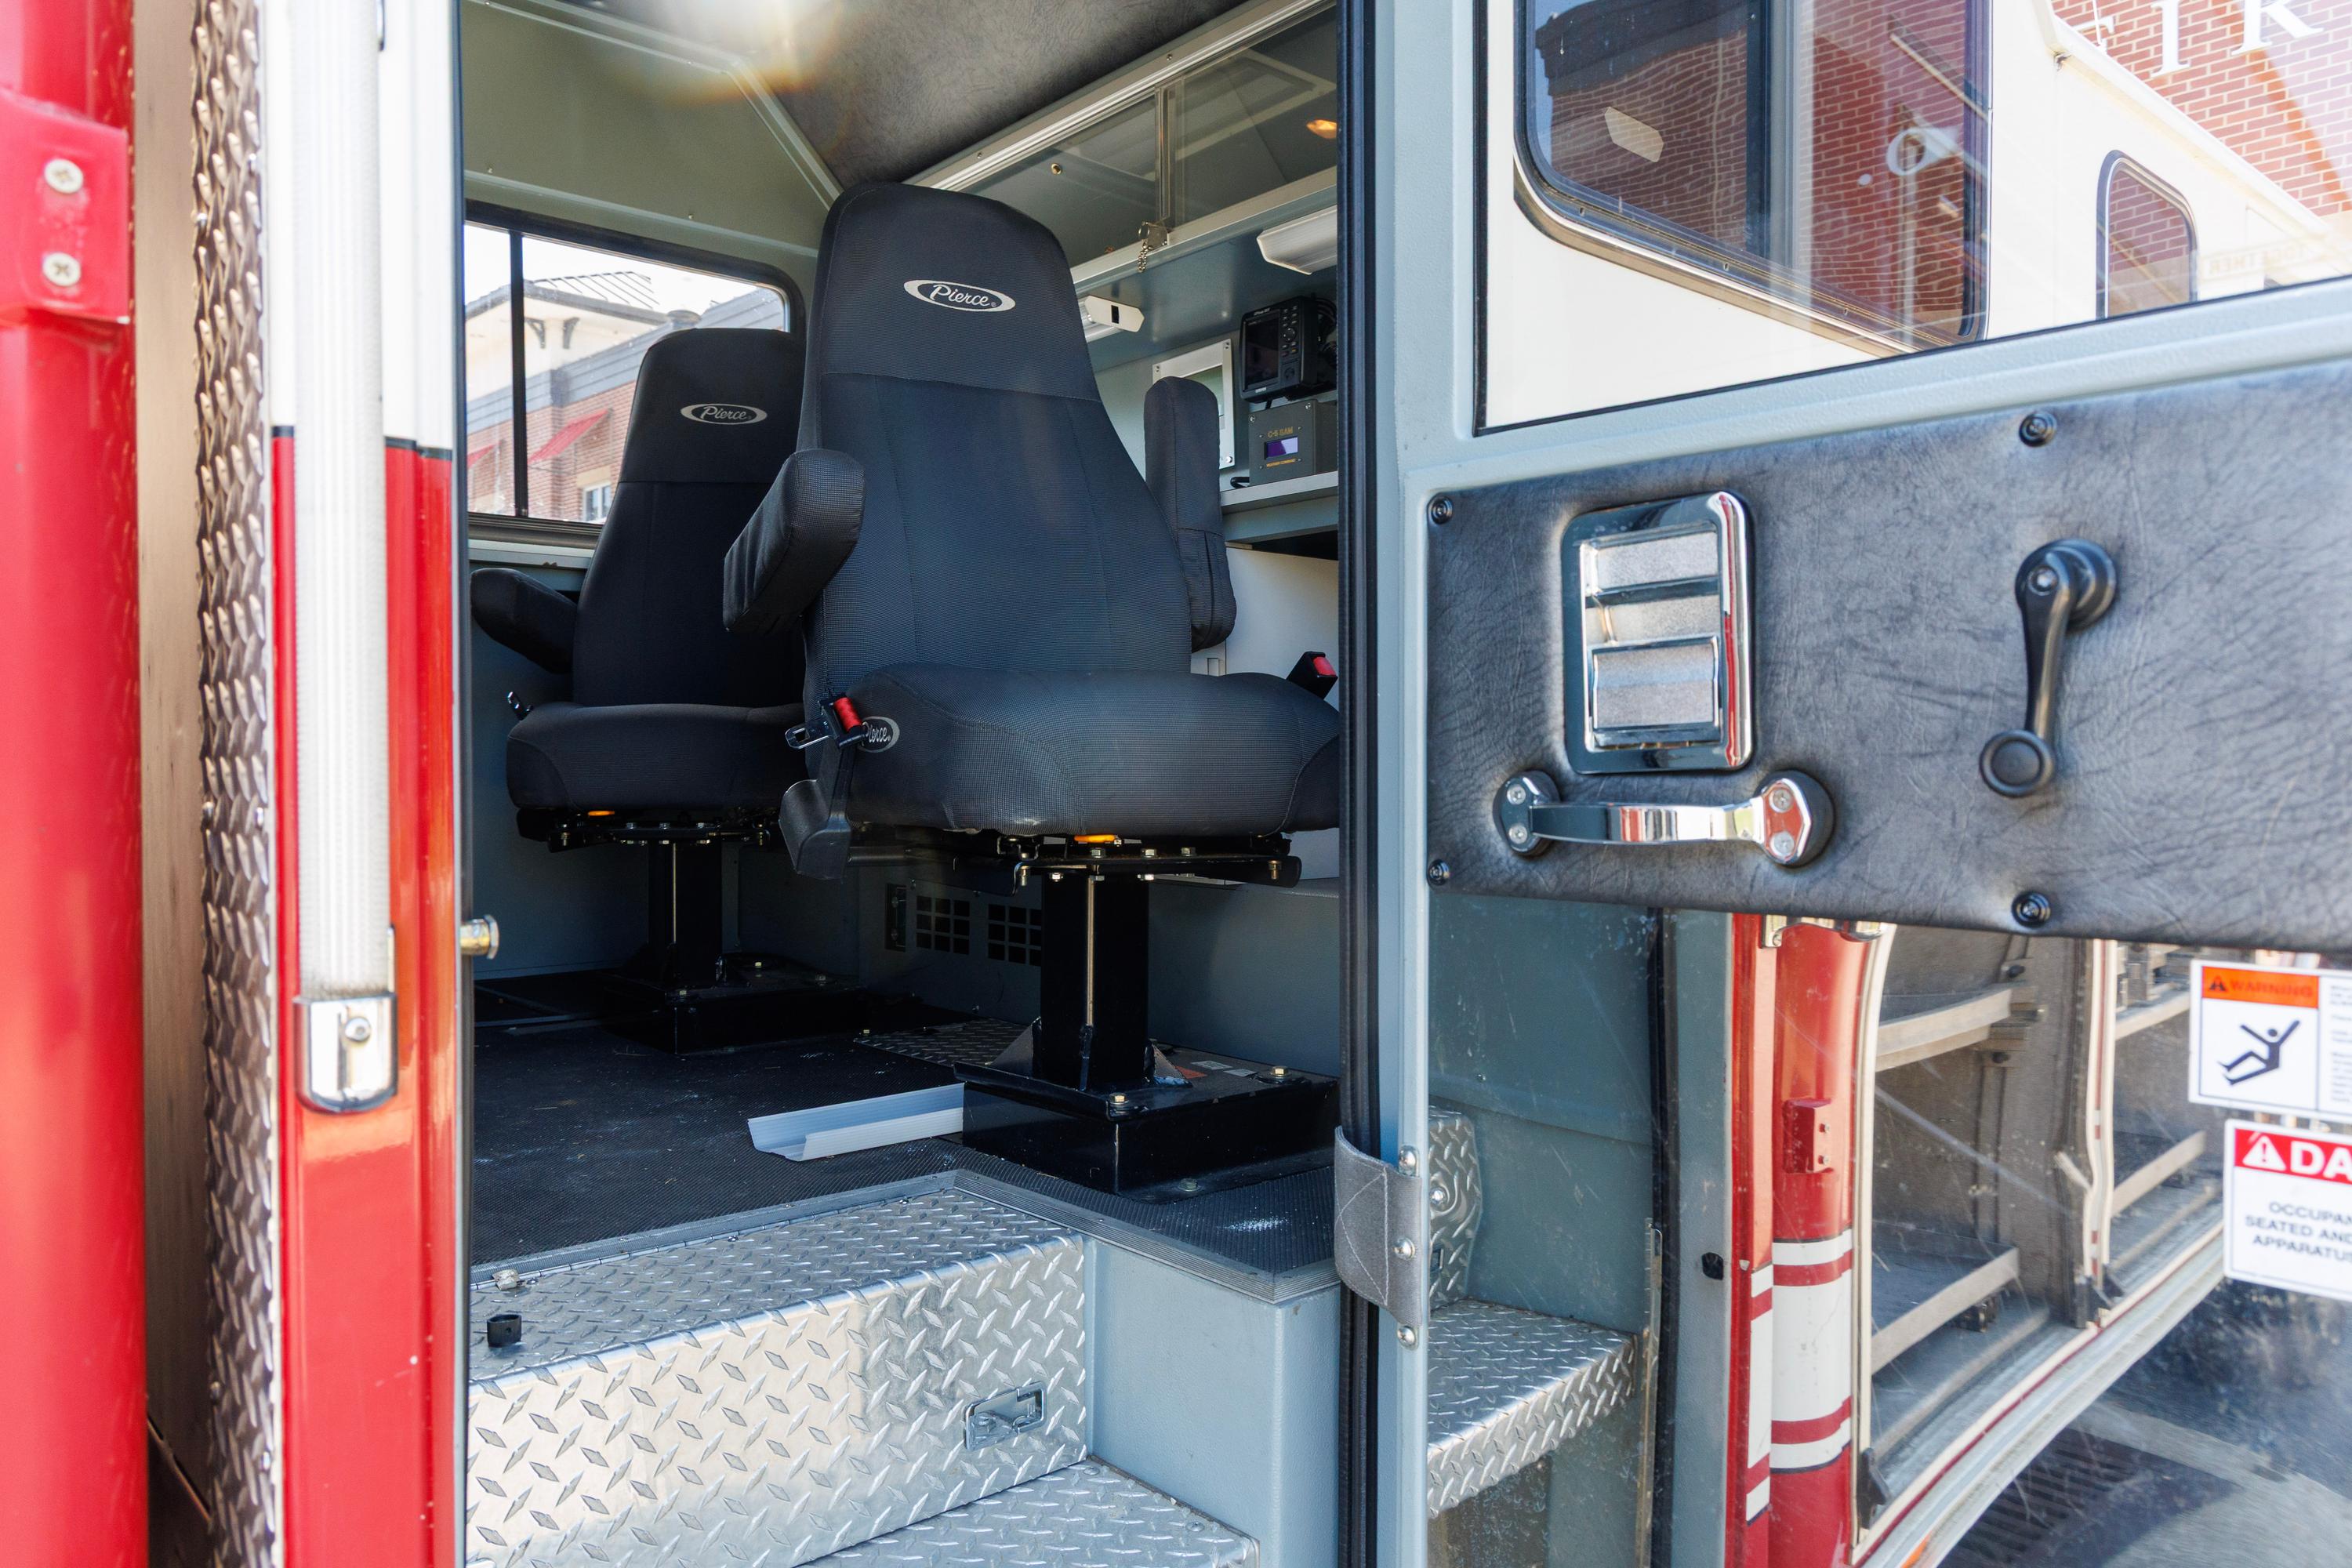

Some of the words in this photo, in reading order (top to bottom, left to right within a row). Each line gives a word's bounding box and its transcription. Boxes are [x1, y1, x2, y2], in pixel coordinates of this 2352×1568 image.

[699, 405, 747, 420] Pierce
[2230, 978, 2313, 998] WARNING
[2245, 1215, 2313, 1236] SEATED
